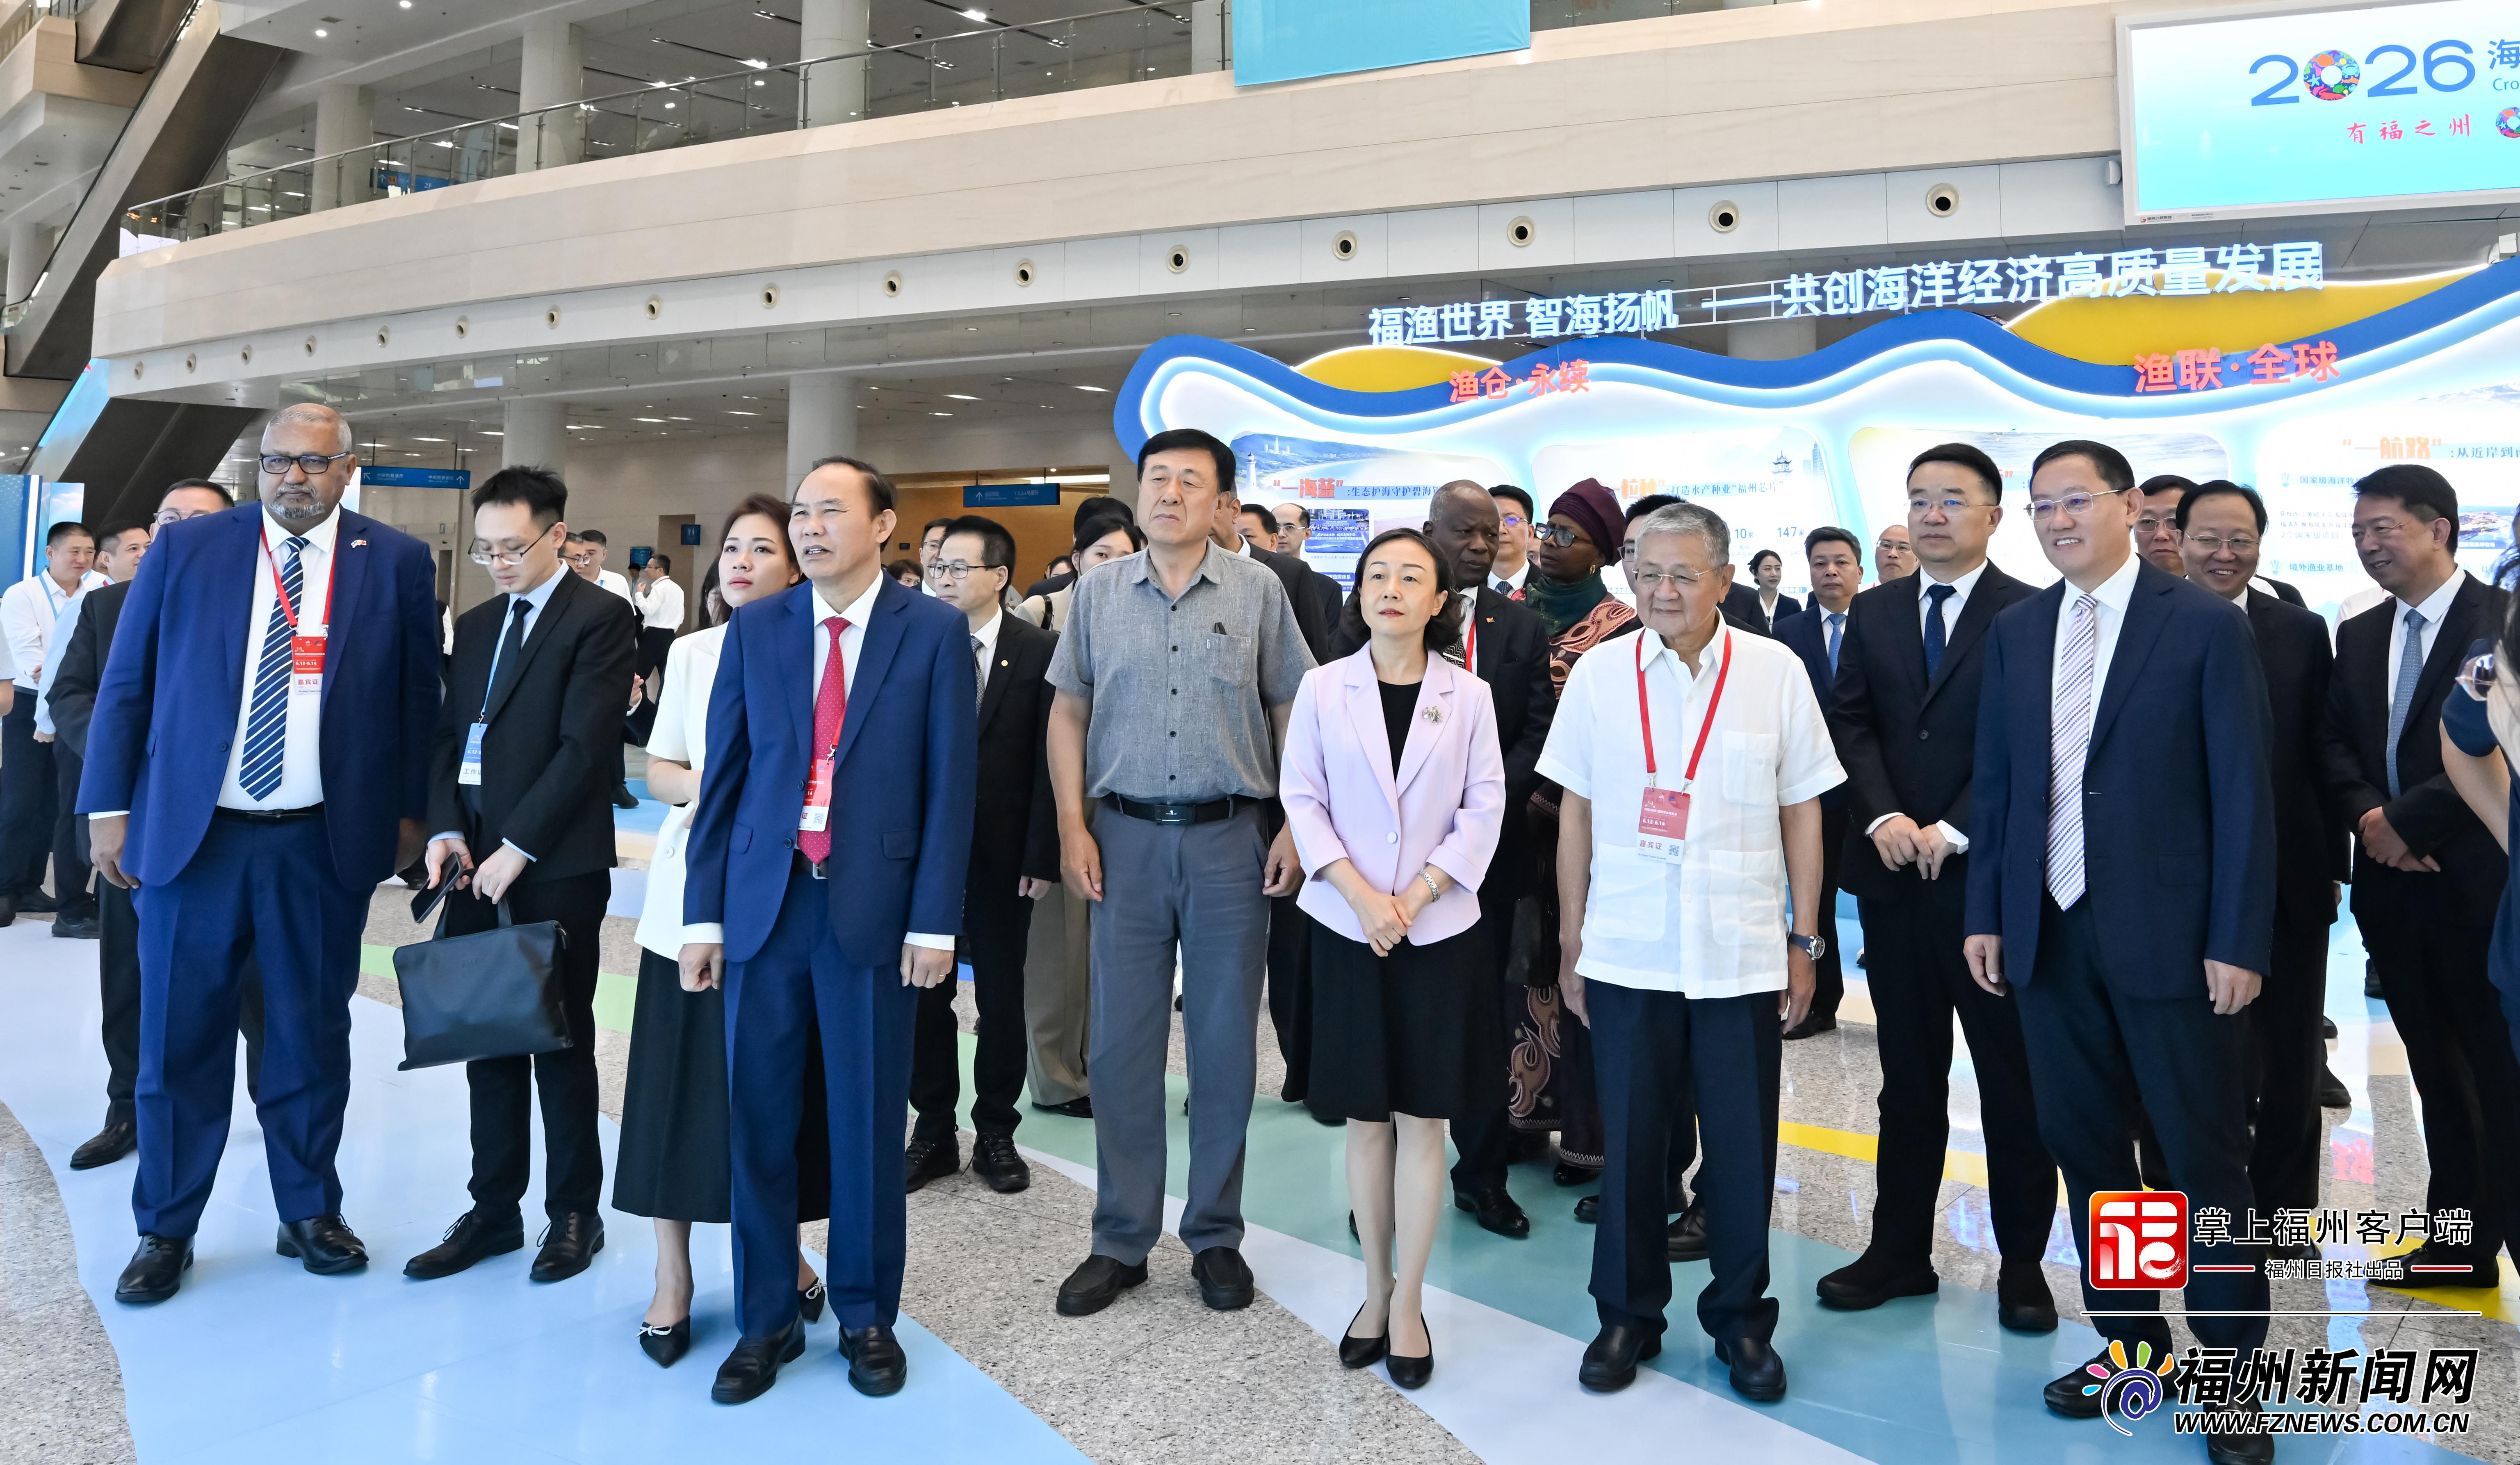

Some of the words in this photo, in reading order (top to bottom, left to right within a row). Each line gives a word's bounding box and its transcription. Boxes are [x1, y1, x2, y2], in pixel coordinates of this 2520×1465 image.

[2249, 39, 2475, 106] 2026
[2347, 113, 2471, 145] 有福之州
[1368, 301, 1514, 346] 福渔世界
[1526, 289, 1679, 339] 智海扬帆
[1450, 359, 1590, 403] 渔仓·永续
[2134, 340, 2340, 394] 渔联·全球
[2300, 476, 2358, 485] 国家级海洋牧
